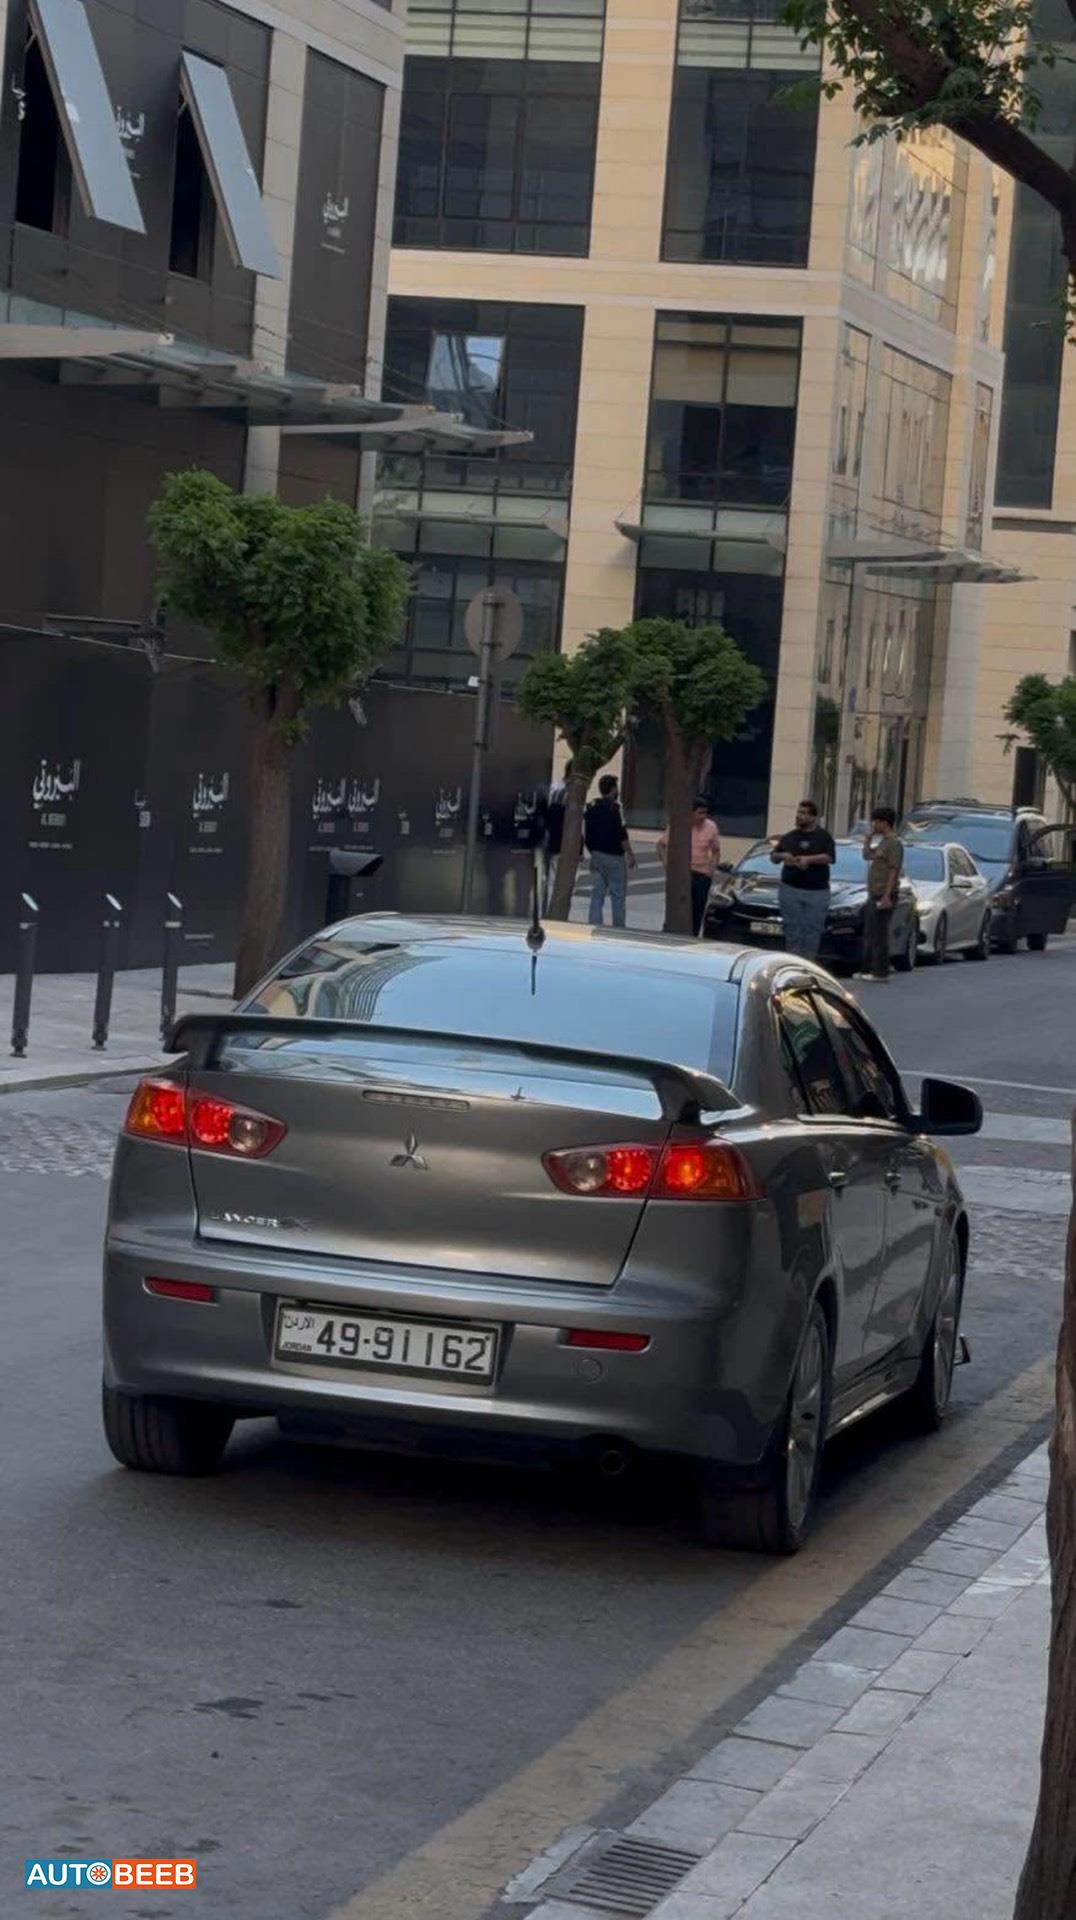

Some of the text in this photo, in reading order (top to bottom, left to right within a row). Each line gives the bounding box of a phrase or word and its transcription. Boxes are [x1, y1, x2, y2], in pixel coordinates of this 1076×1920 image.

[32, 758, 80, 810] البيروتي
[192, 772, 230, 819] البيروتي
[312, 778, 346, 820] البيروتي
[282, 1341, 313, 1353] JORDAN
[316, 1320, 486, 1372] 49-91162
